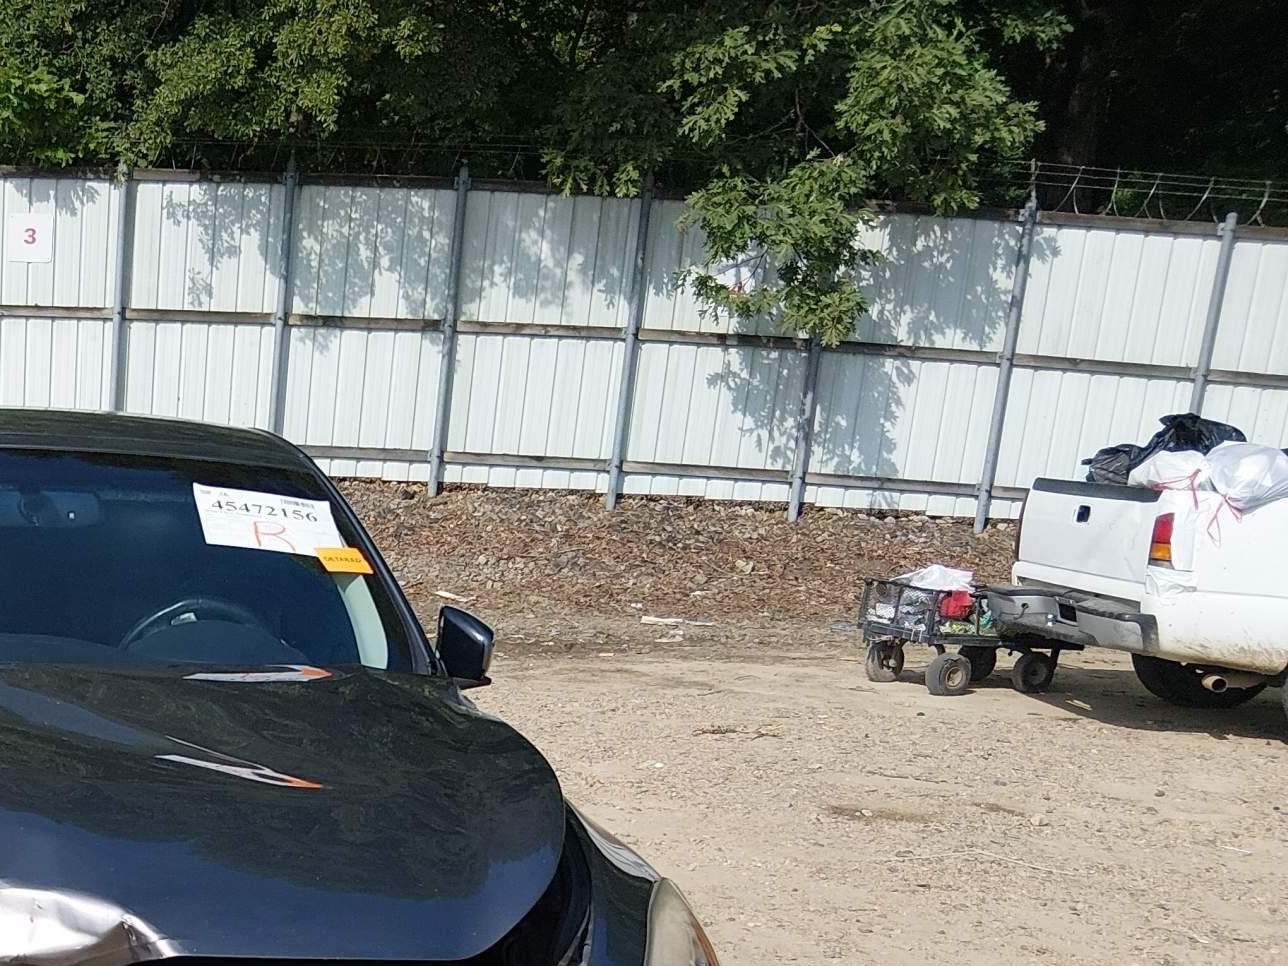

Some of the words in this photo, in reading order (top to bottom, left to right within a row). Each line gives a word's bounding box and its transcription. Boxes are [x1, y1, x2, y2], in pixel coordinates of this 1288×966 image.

[23, 228, 37, 245] 3
[211, 499, 318, 523] 45472156
[253, 520, 296, 553] R
